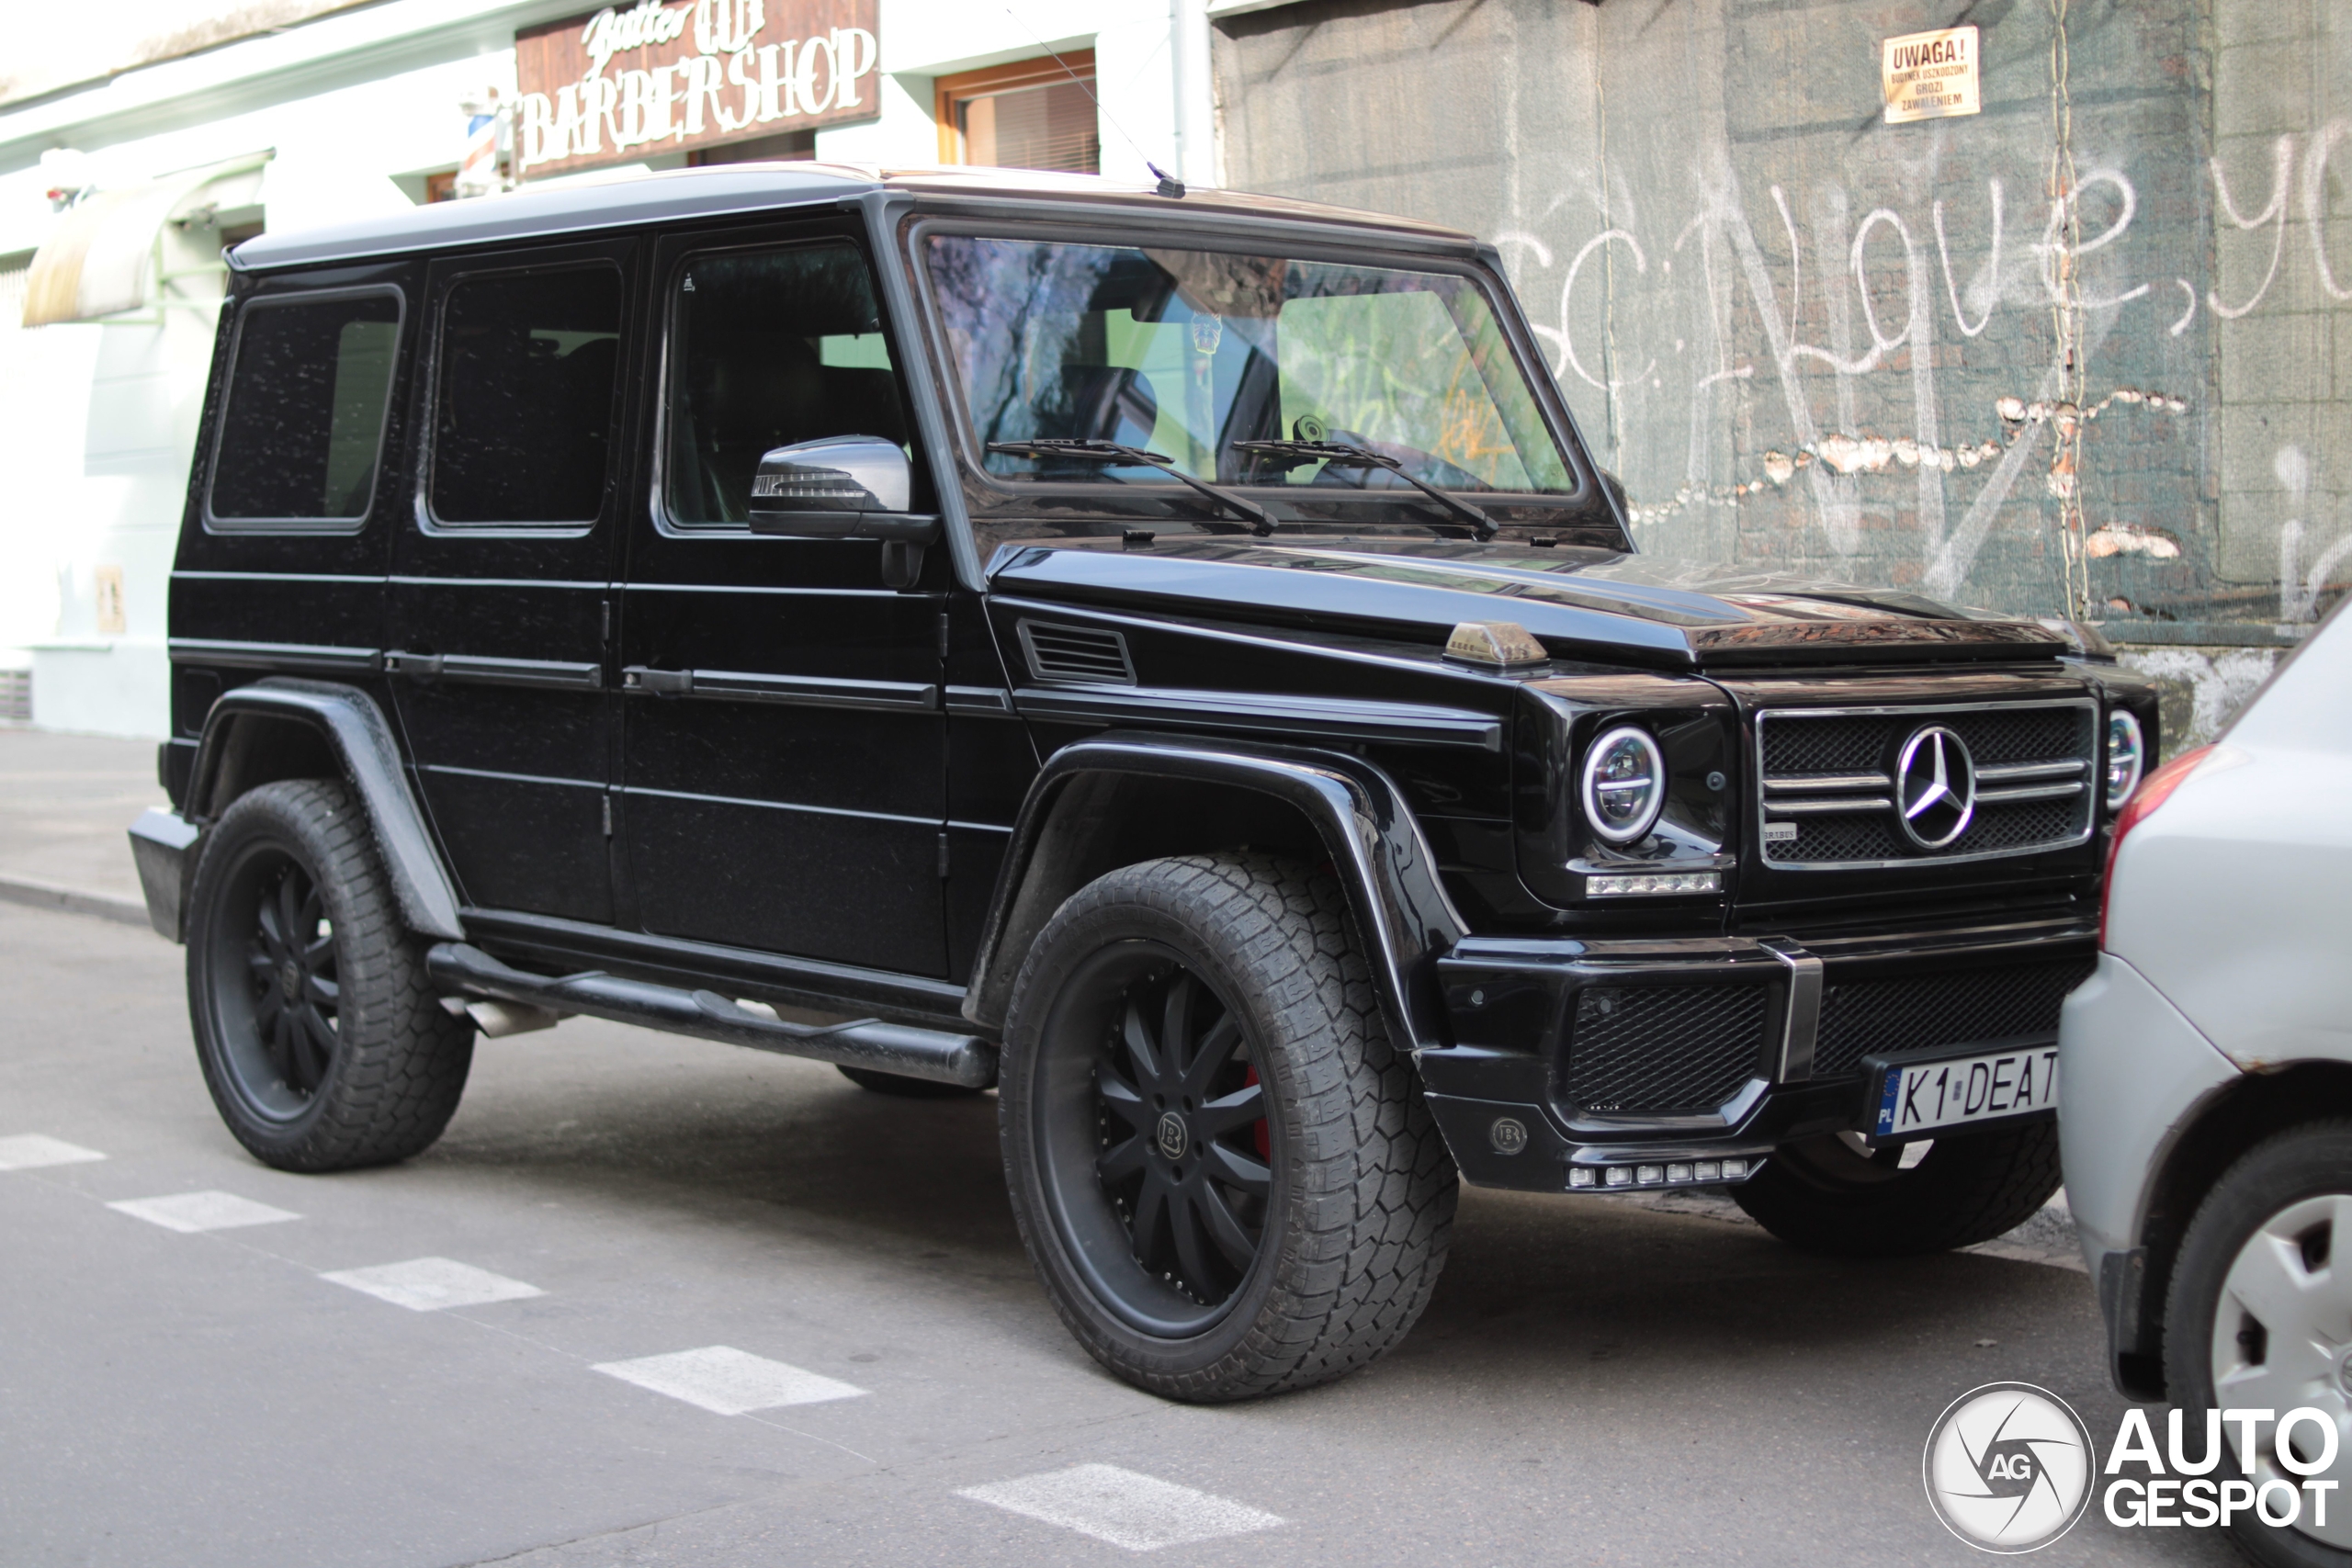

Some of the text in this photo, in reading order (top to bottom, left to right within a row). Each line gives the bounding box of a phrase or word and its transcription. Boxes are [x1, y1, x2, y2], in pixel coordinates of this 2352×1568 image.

[1891, 64, 1969, 84] BUDYNEK USZKODZONY
[516, 28, 877, 172] BARBERSHOP
[1902, 94, 1962, 111] ZAWALENIEM
[1916, 81, 1943, 96] GROZI
[1063, 907, 1169, 946] RENEGADE
[1902, 1066, 1950, 1126] K1
[1878, 1108, 1893, 1124] PL
[1161, 1117, 1182, 1154] B
